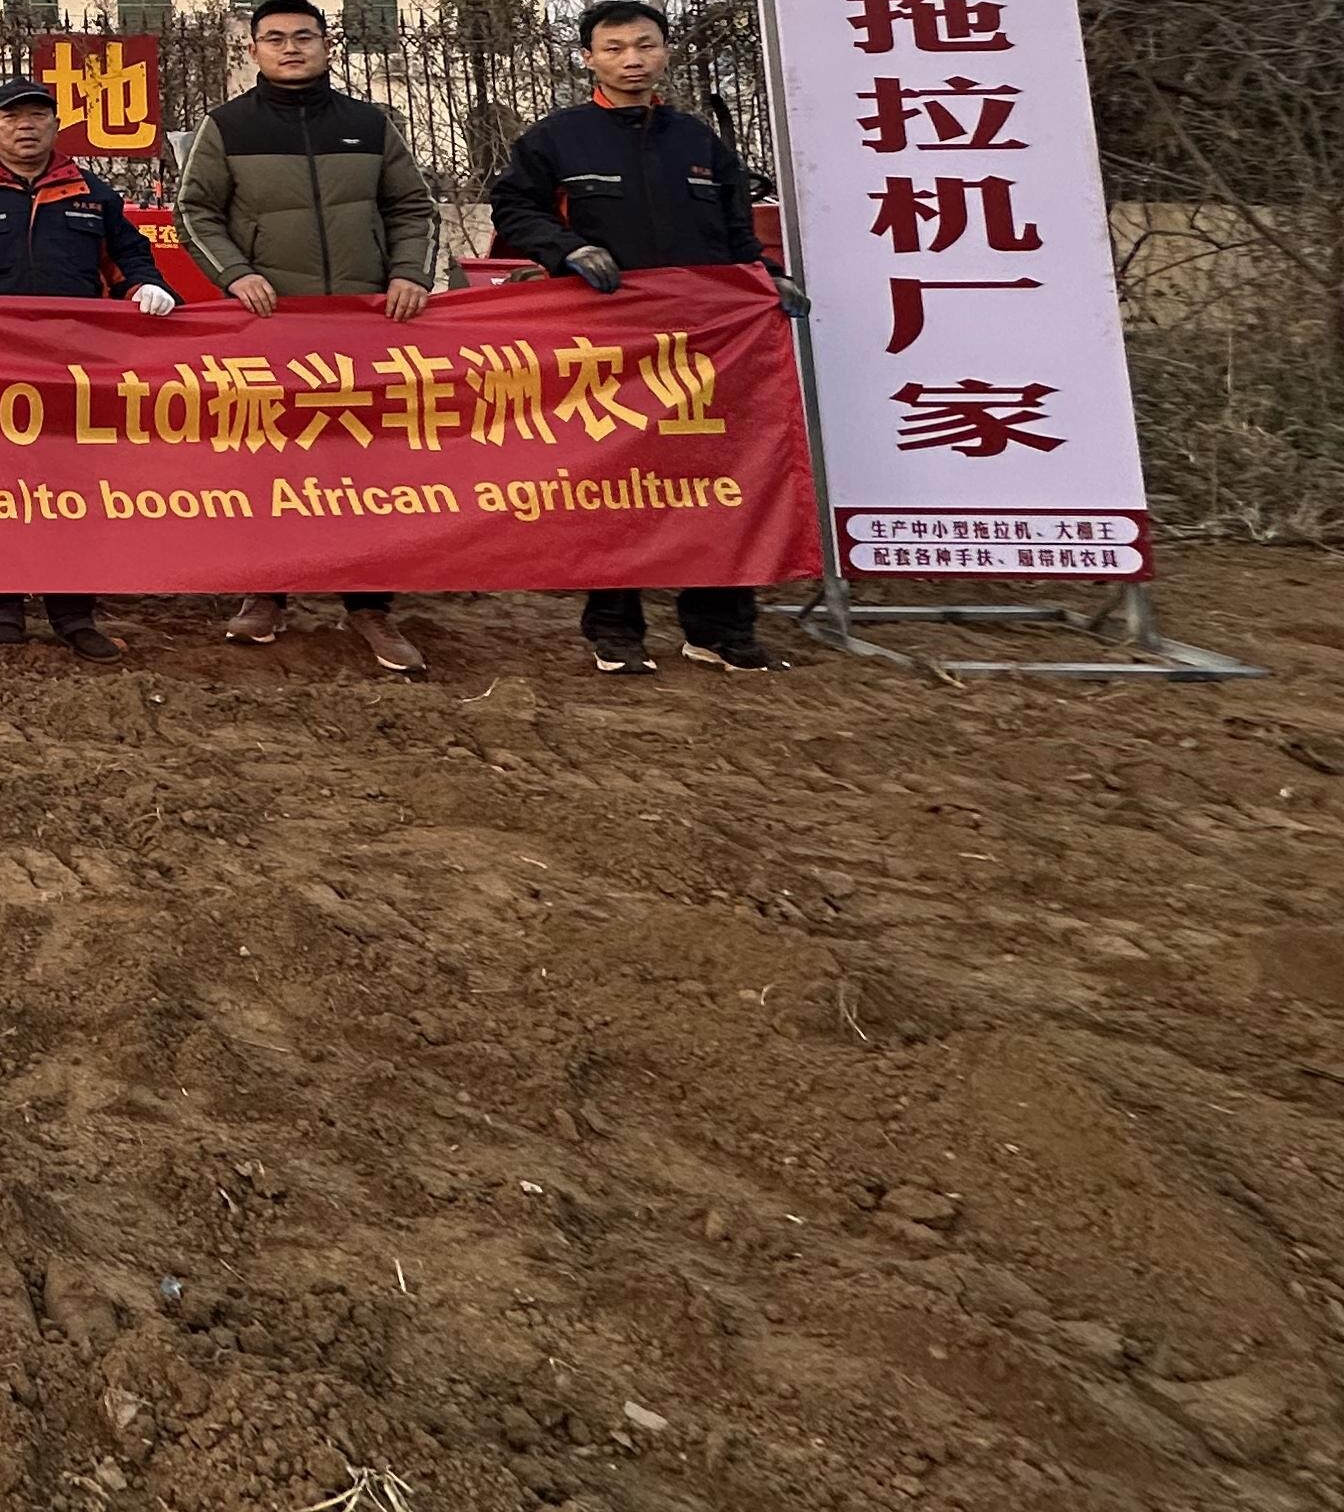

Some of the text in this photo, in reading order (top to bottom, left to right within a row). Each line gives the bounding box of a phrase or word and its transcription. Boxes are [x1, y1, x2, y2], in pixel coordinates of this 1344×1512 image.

[100, 481, 253, 519] boom
[271, 477, 460, 518] African
[475, 468, 743, 522] agriculture
